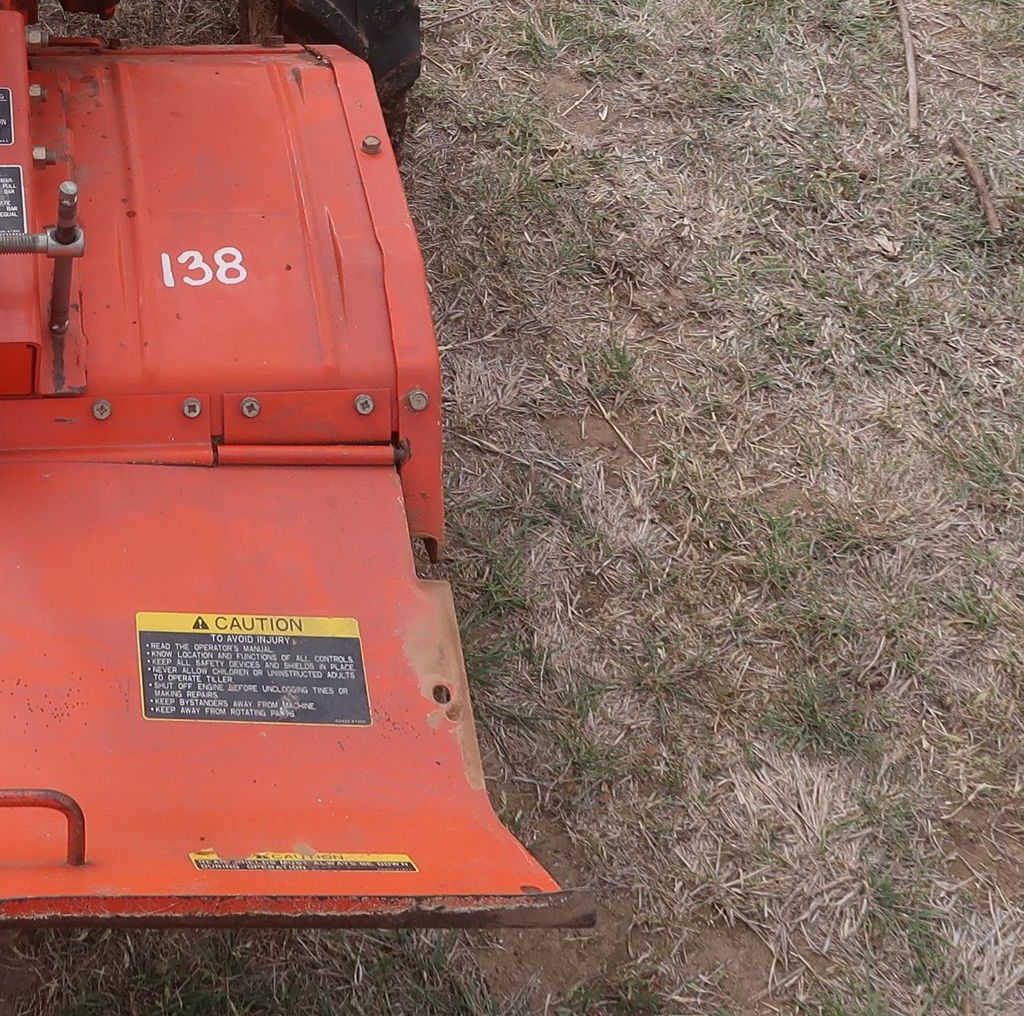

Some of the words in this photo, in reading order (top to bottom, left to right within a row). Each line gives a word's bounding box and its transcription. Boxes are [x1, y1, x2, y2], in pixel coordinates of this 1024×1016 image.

[161, 247, 247, 288] 138
[215, 616, 303, 632] CAUTION
[211, 634, 223, 642] TO
[227, 635, 254, 643] AVOID
[257, 636, 290, 645] INJURY
[237, 653, 277, 661] FUNCTIONS
[196, 660, 225, 668] SAFETY
[229, 661, 261, 669] DEVICES
[284, 663, 315, 671] SHIELDS
[168, 675, 202, 683] OPERATE
[268, 671, 323, 679] UNINSTRUCTED
[327, 672, 356, 680] ADULTS
[154, 682, 174, 690] SHUT
[198, 684, 225, 692] ENGINE
[228, 685, 259, 693] BEFORE
[262, 685, 309, 694] UNCLOGGING
[312, 687, 335, 695] TINES
[180, 699, 229, 708] BYSTANDERS
[233, 700, 254, 708] AWAY
[156, 706, 176, 714] KEEP
[181, 707, 200, 715] AWAY
[205, 708, 227, 716] FROM
[231, 709, 267, 717] ROTATING
